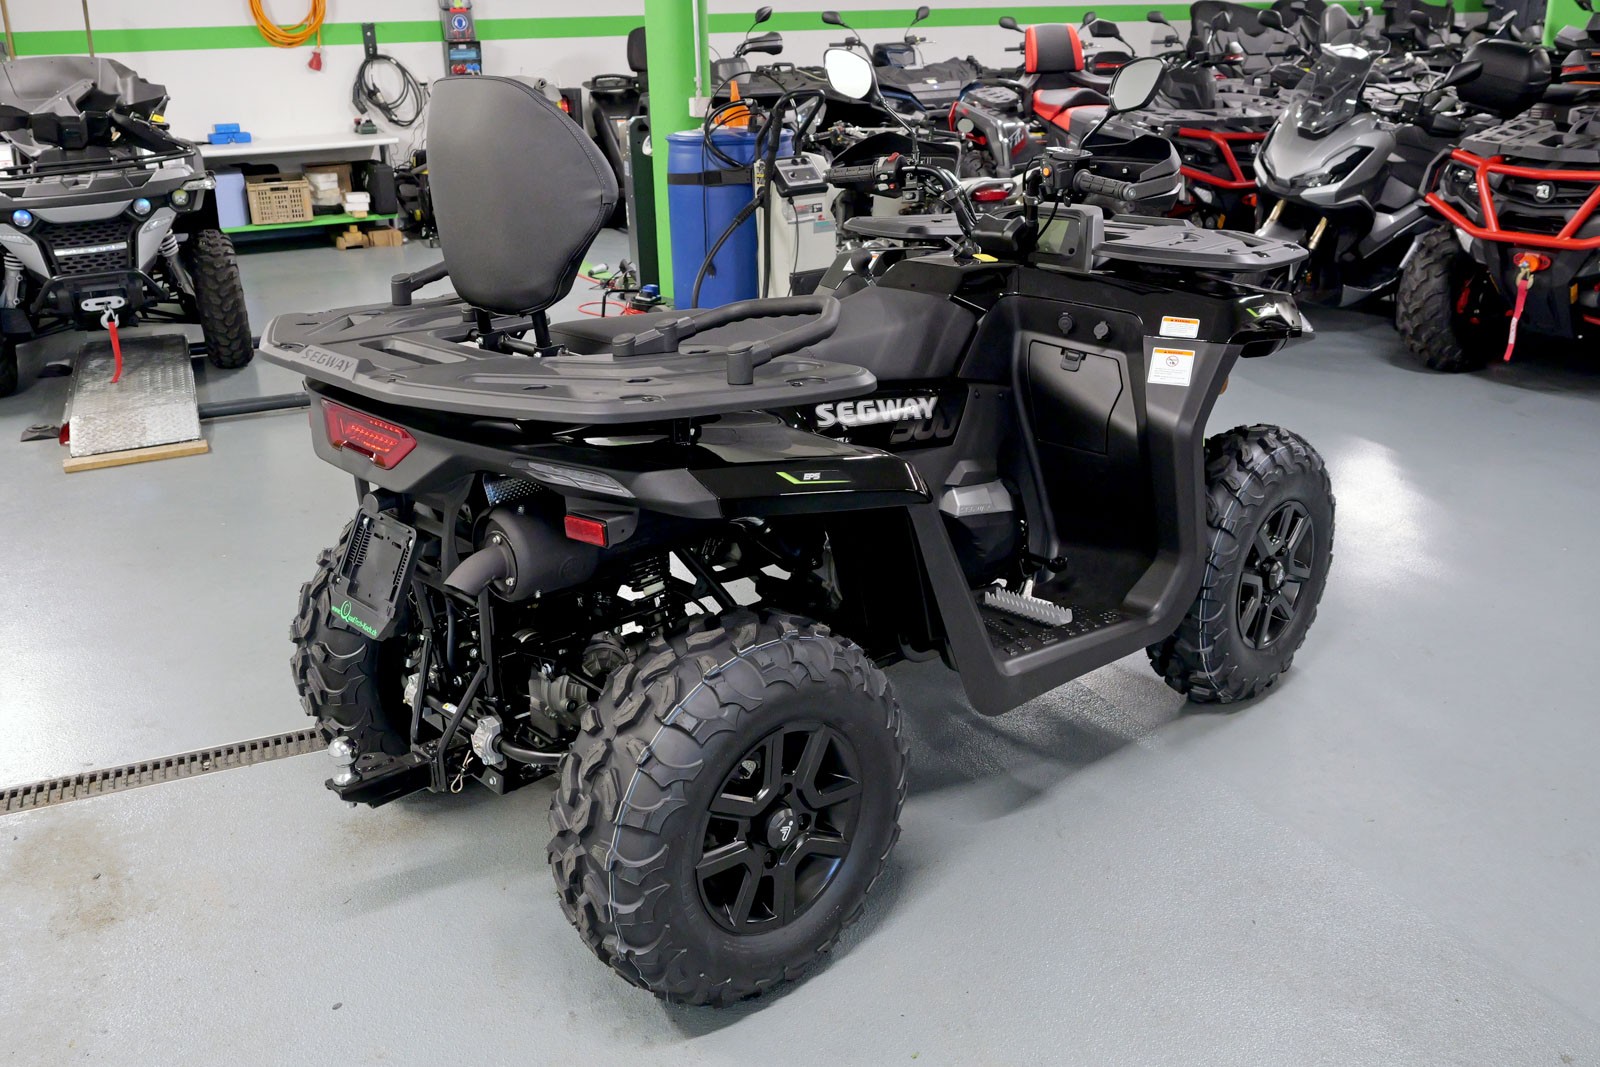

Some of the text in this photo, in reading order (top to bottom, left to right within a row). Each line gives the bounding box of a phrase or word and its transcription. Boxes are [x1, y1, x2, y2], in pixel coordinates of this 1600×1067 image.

[301, 349, 354, 372] SEGWAY
[814, 397, 938, 428] SEGWAY
[803, 472, 821, 481] EPS
